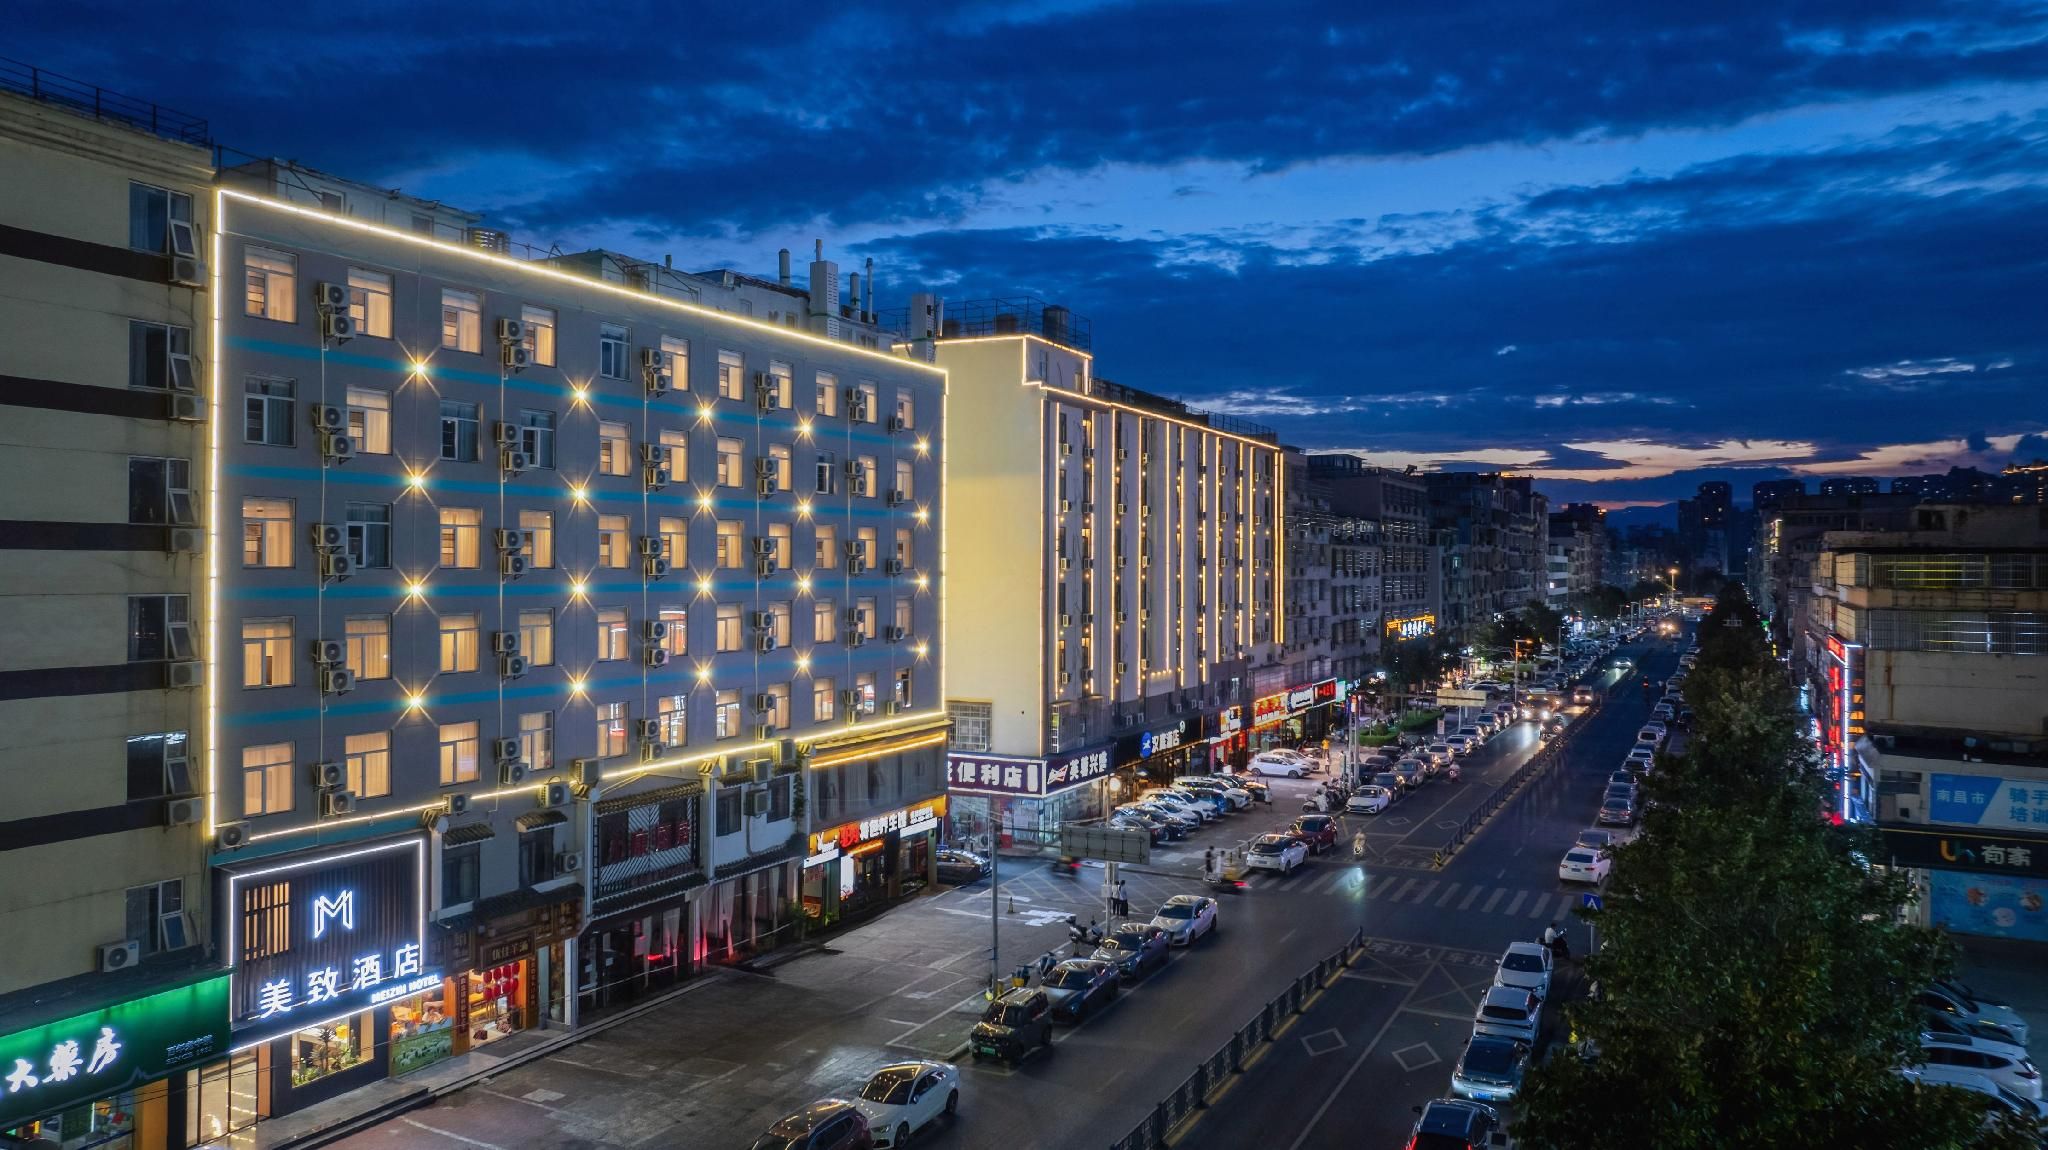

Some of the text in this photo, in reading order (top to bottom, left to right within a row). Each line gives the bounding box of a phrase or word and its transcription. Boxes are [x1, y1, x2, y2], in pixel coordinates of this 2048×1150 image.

[1937, 789, 1985, 804] 南昌市
[260, 944, 420, 1018] 美致酒店
[408, 974, 441, 992] HOTEL
